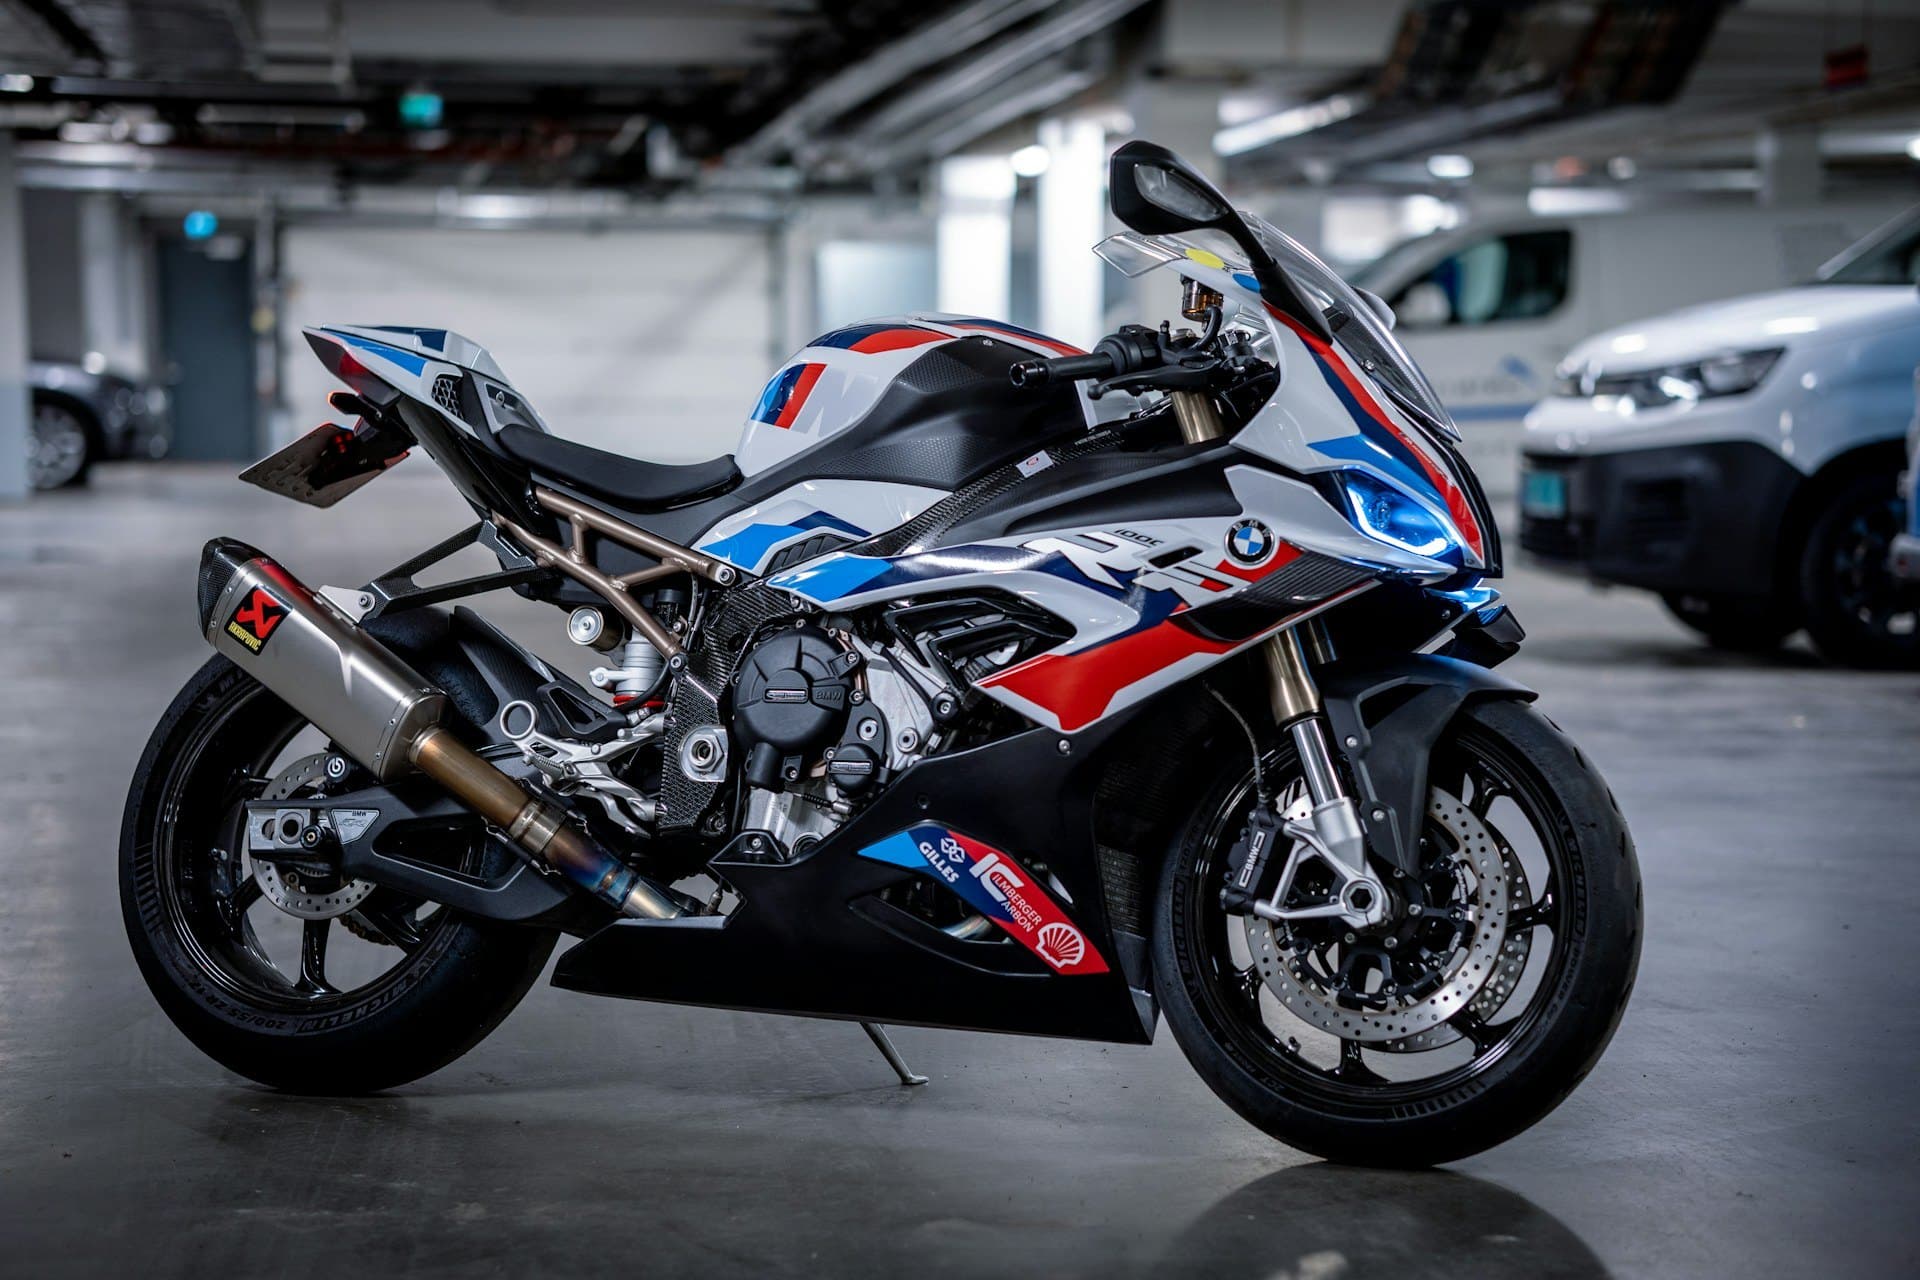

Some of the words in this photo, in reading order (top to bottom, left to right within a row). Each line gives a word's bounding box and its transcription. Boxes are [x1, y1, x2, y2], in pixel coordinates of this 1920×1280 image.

[1231, 519, 1271, 537] BMW
[815, 690, 842, 704] BMW
[918, 841, 960, 884] GILLES
[1244, 845, 1261, 871] BMW
[991, 873, 1043, 926] ILMBERGER
[227, 1008, 287, 1029] 200/55
[299, 980, 408, 1032] MICHELIN
